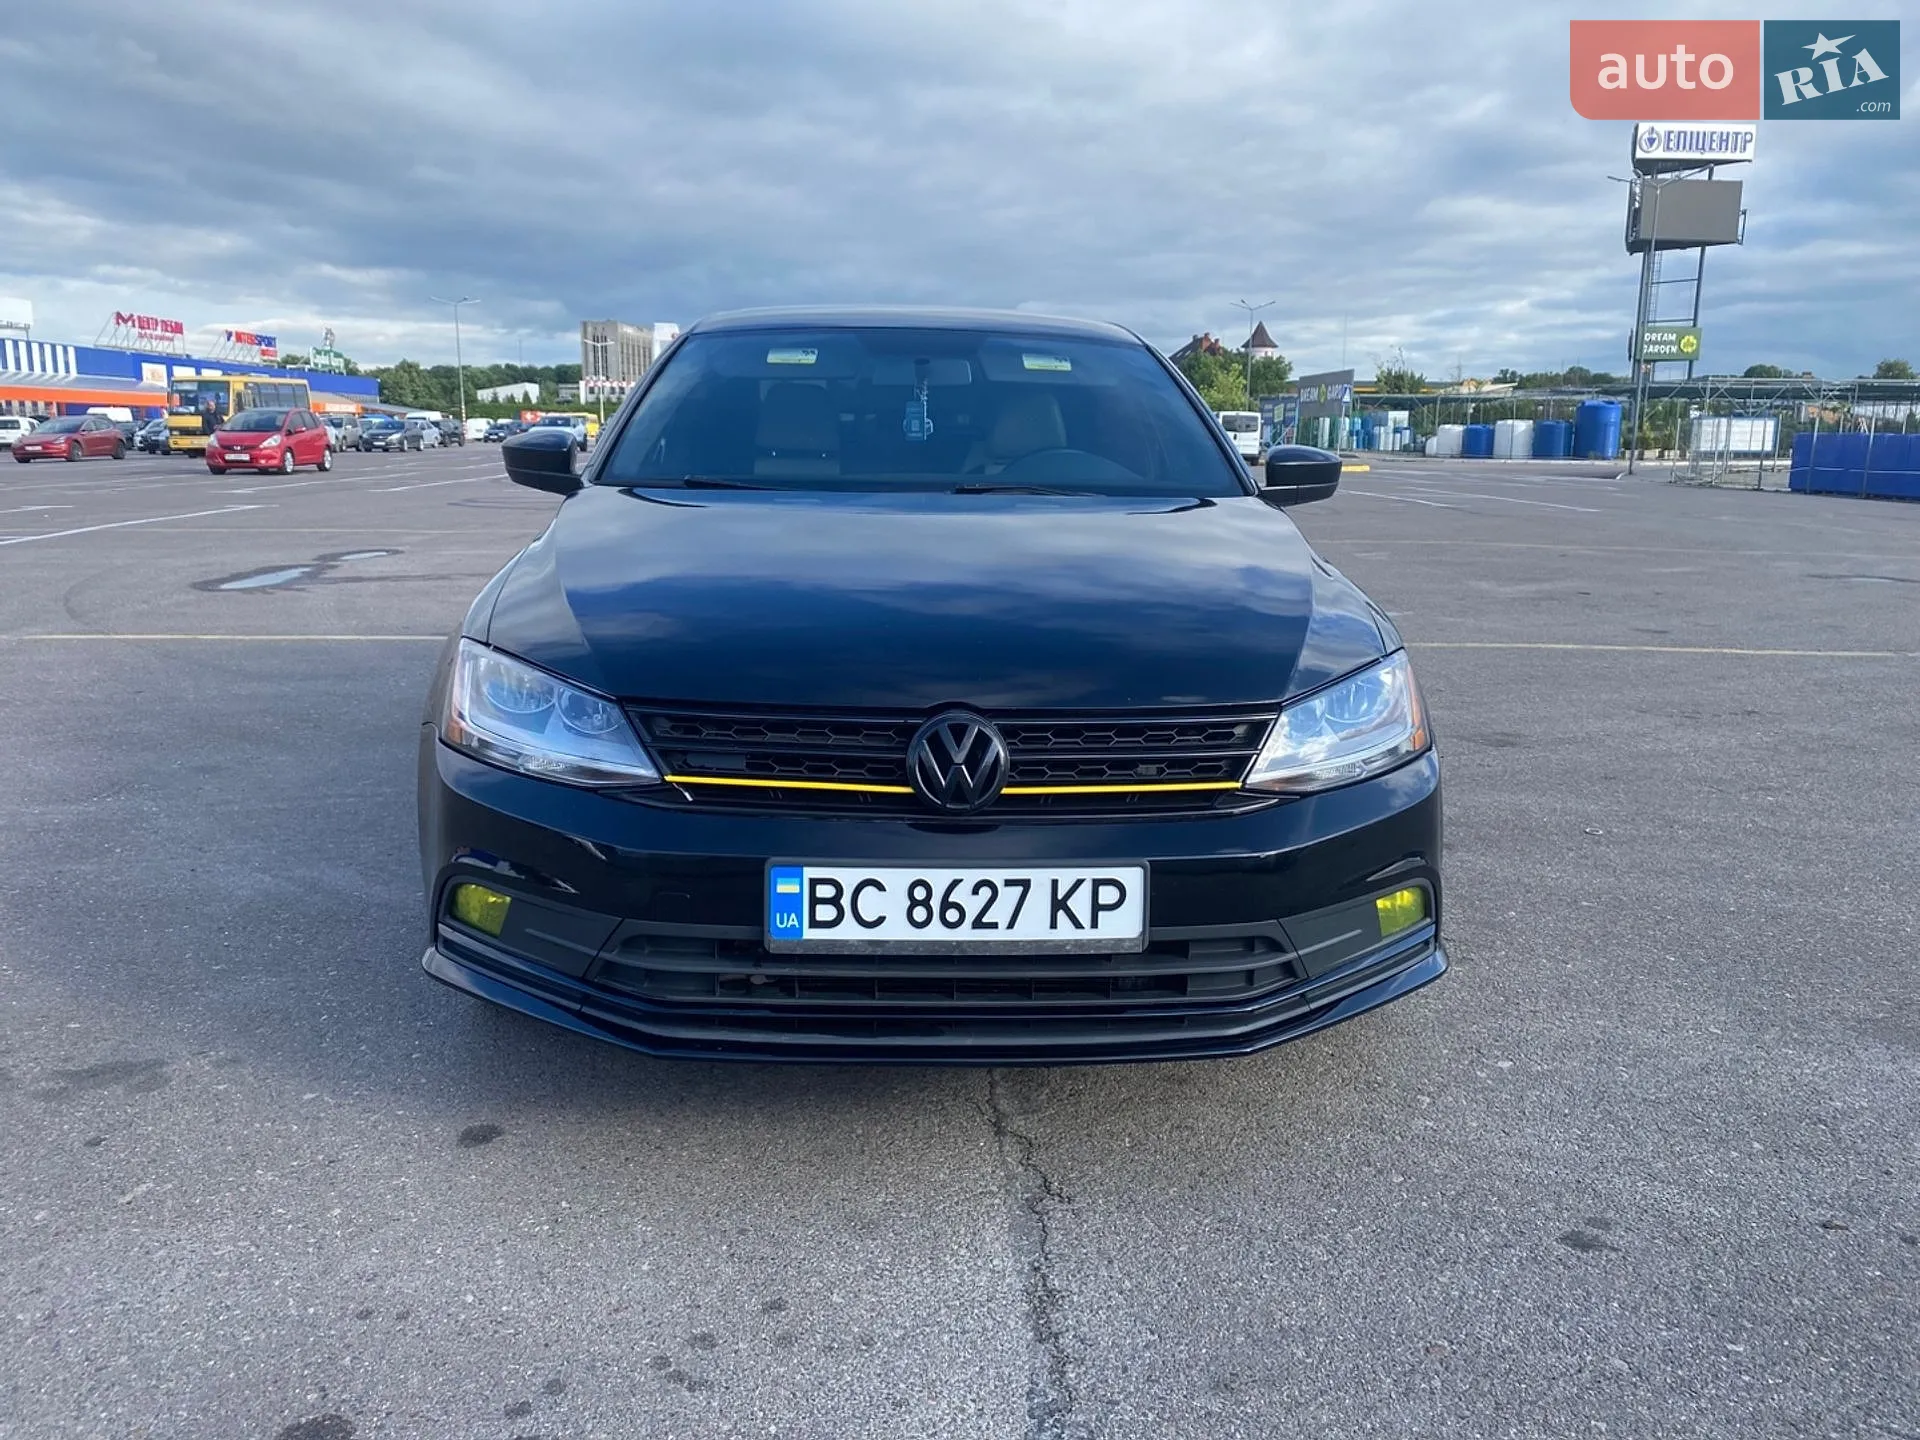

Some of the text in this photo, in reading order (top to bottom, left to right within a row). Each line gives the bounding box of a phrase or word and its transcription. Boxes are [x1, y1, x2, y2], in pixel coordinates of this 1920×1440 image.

[1663, 130, 1754, 155] ЕПІЦЕНТР
[1644, 332, 1677, 342] DREAM
[807, 877, 1127, 930] BC 8627 KP
[776, 913, 800, 929] UA
